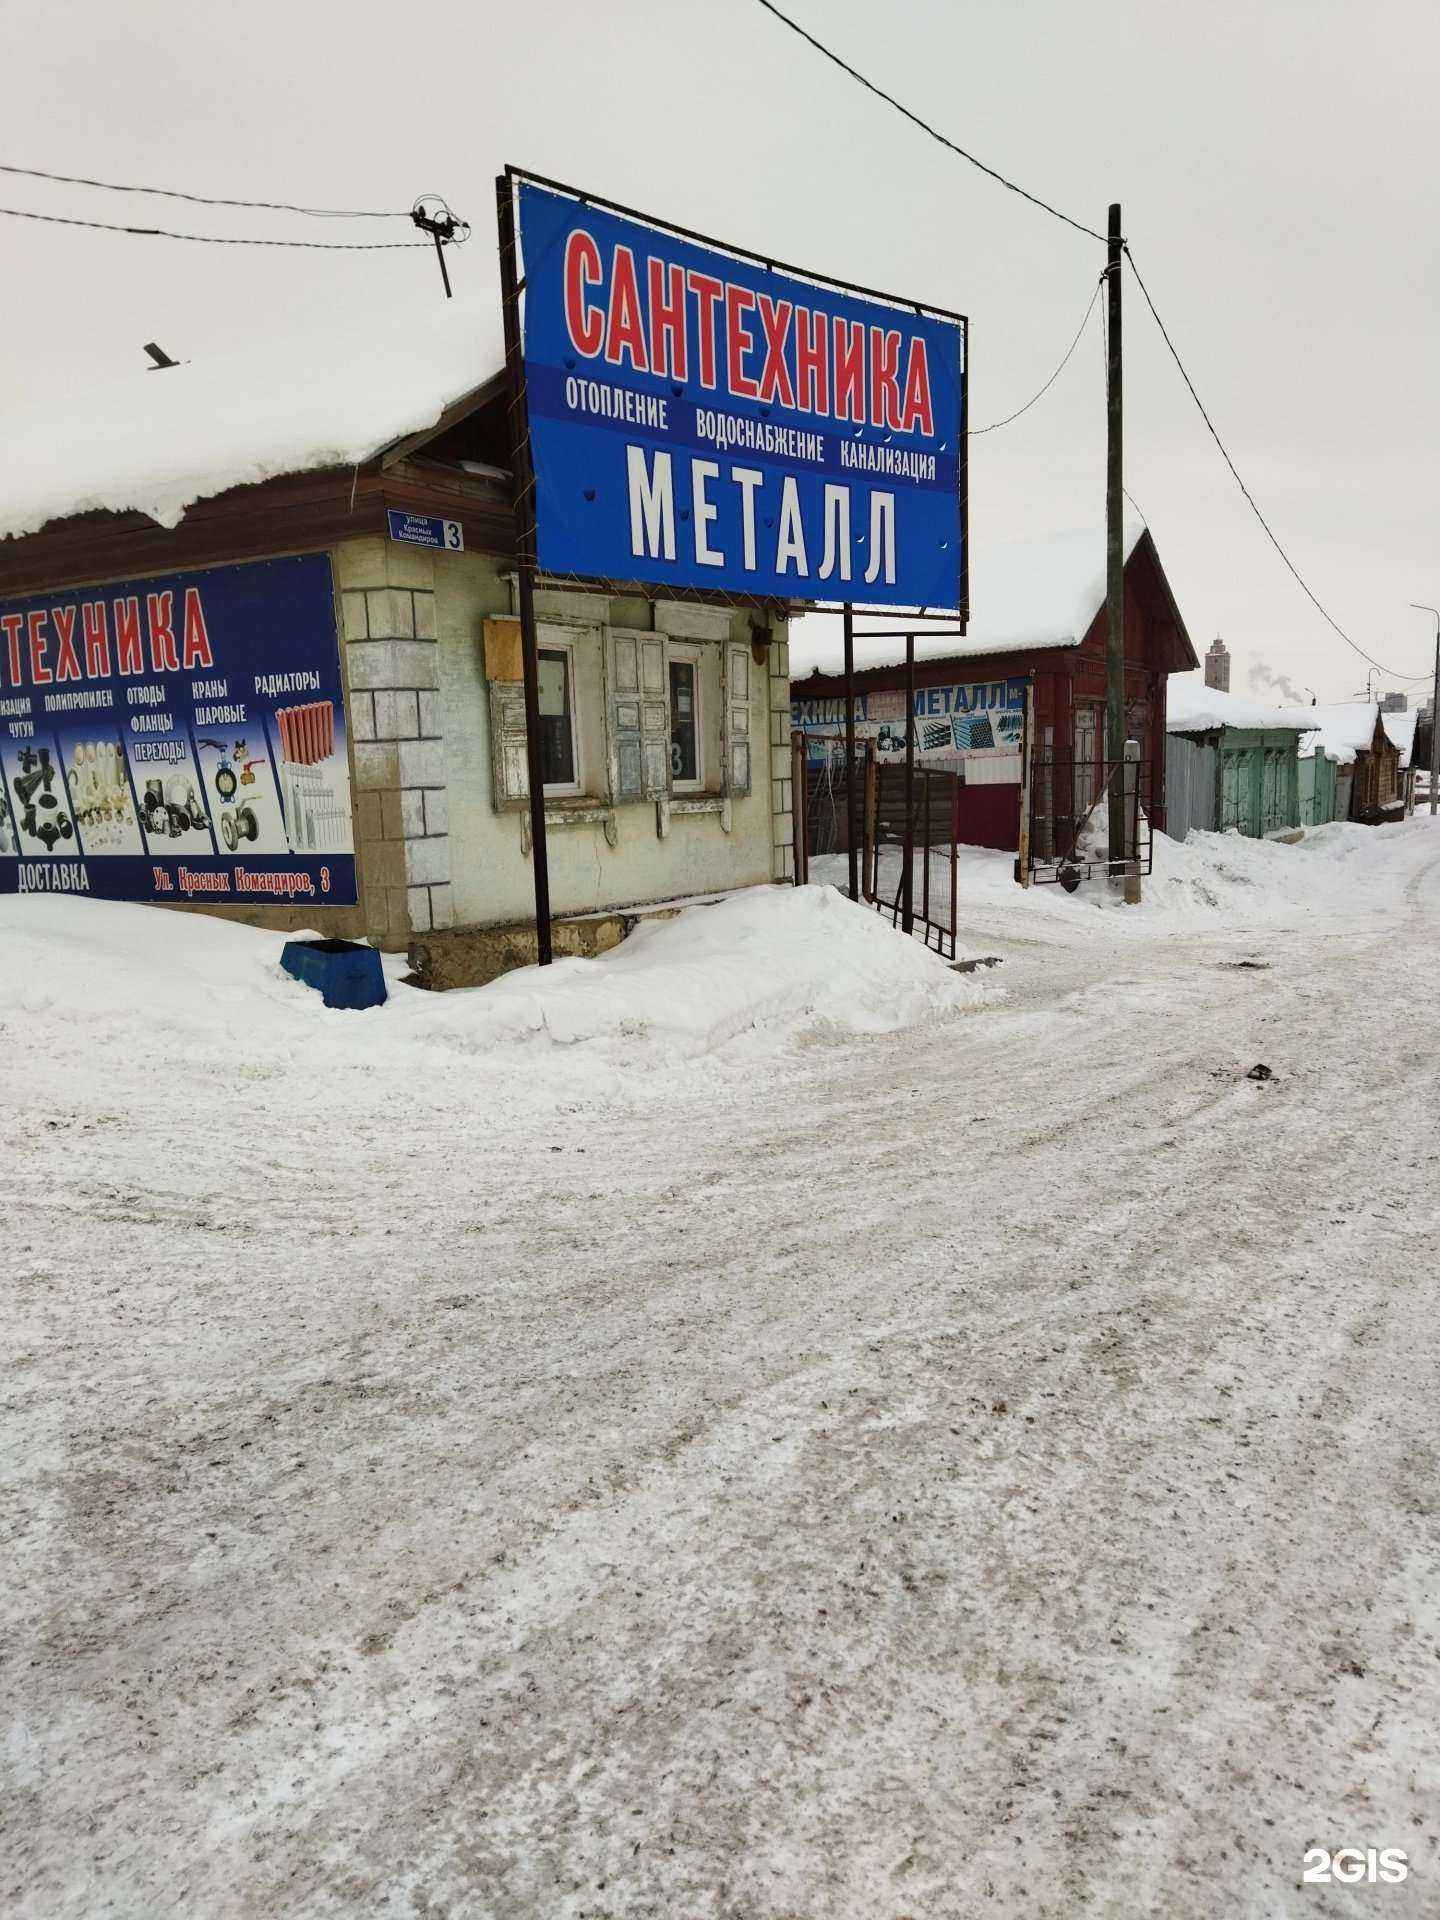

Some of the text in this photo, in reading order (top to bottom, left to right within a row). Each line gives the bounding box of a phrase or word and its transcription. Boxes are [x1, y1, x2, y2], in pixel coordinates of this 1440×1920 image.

[564, 229, 934, 437] САНТЕХНИКА
[565, 376, 936, 484] ОТОПЛЕНИЕ ВОДОСНАБЖЕНИЕ КАНАЛИЗАЦИЯ
[626, 445, 897, 585] МЕТАЛЛ
[448, 523, 460, 549] 3
[127, 685, 166, 708] ОТВОДЫ
[192, 679, 228, 700] КРАНЫ
[254, 670, 321, 698] РАДИАТОРЫ
[44, 689, 114, 712] ПОЛИПРОПИЛЕН
[130, 713, 173, 734] ФЛАНЦЫ
[195, 704, 247, 725] ШАРОВЫЕ
[8, 721, 34, 738] ЧУГУН
[134, 739, 186, 765] ПЕРЕХОДЫ
[18, 863, 90, 894] ДОСТАВКА
[153, 866, 331, 898] Ул. Красных Командиров, 3
